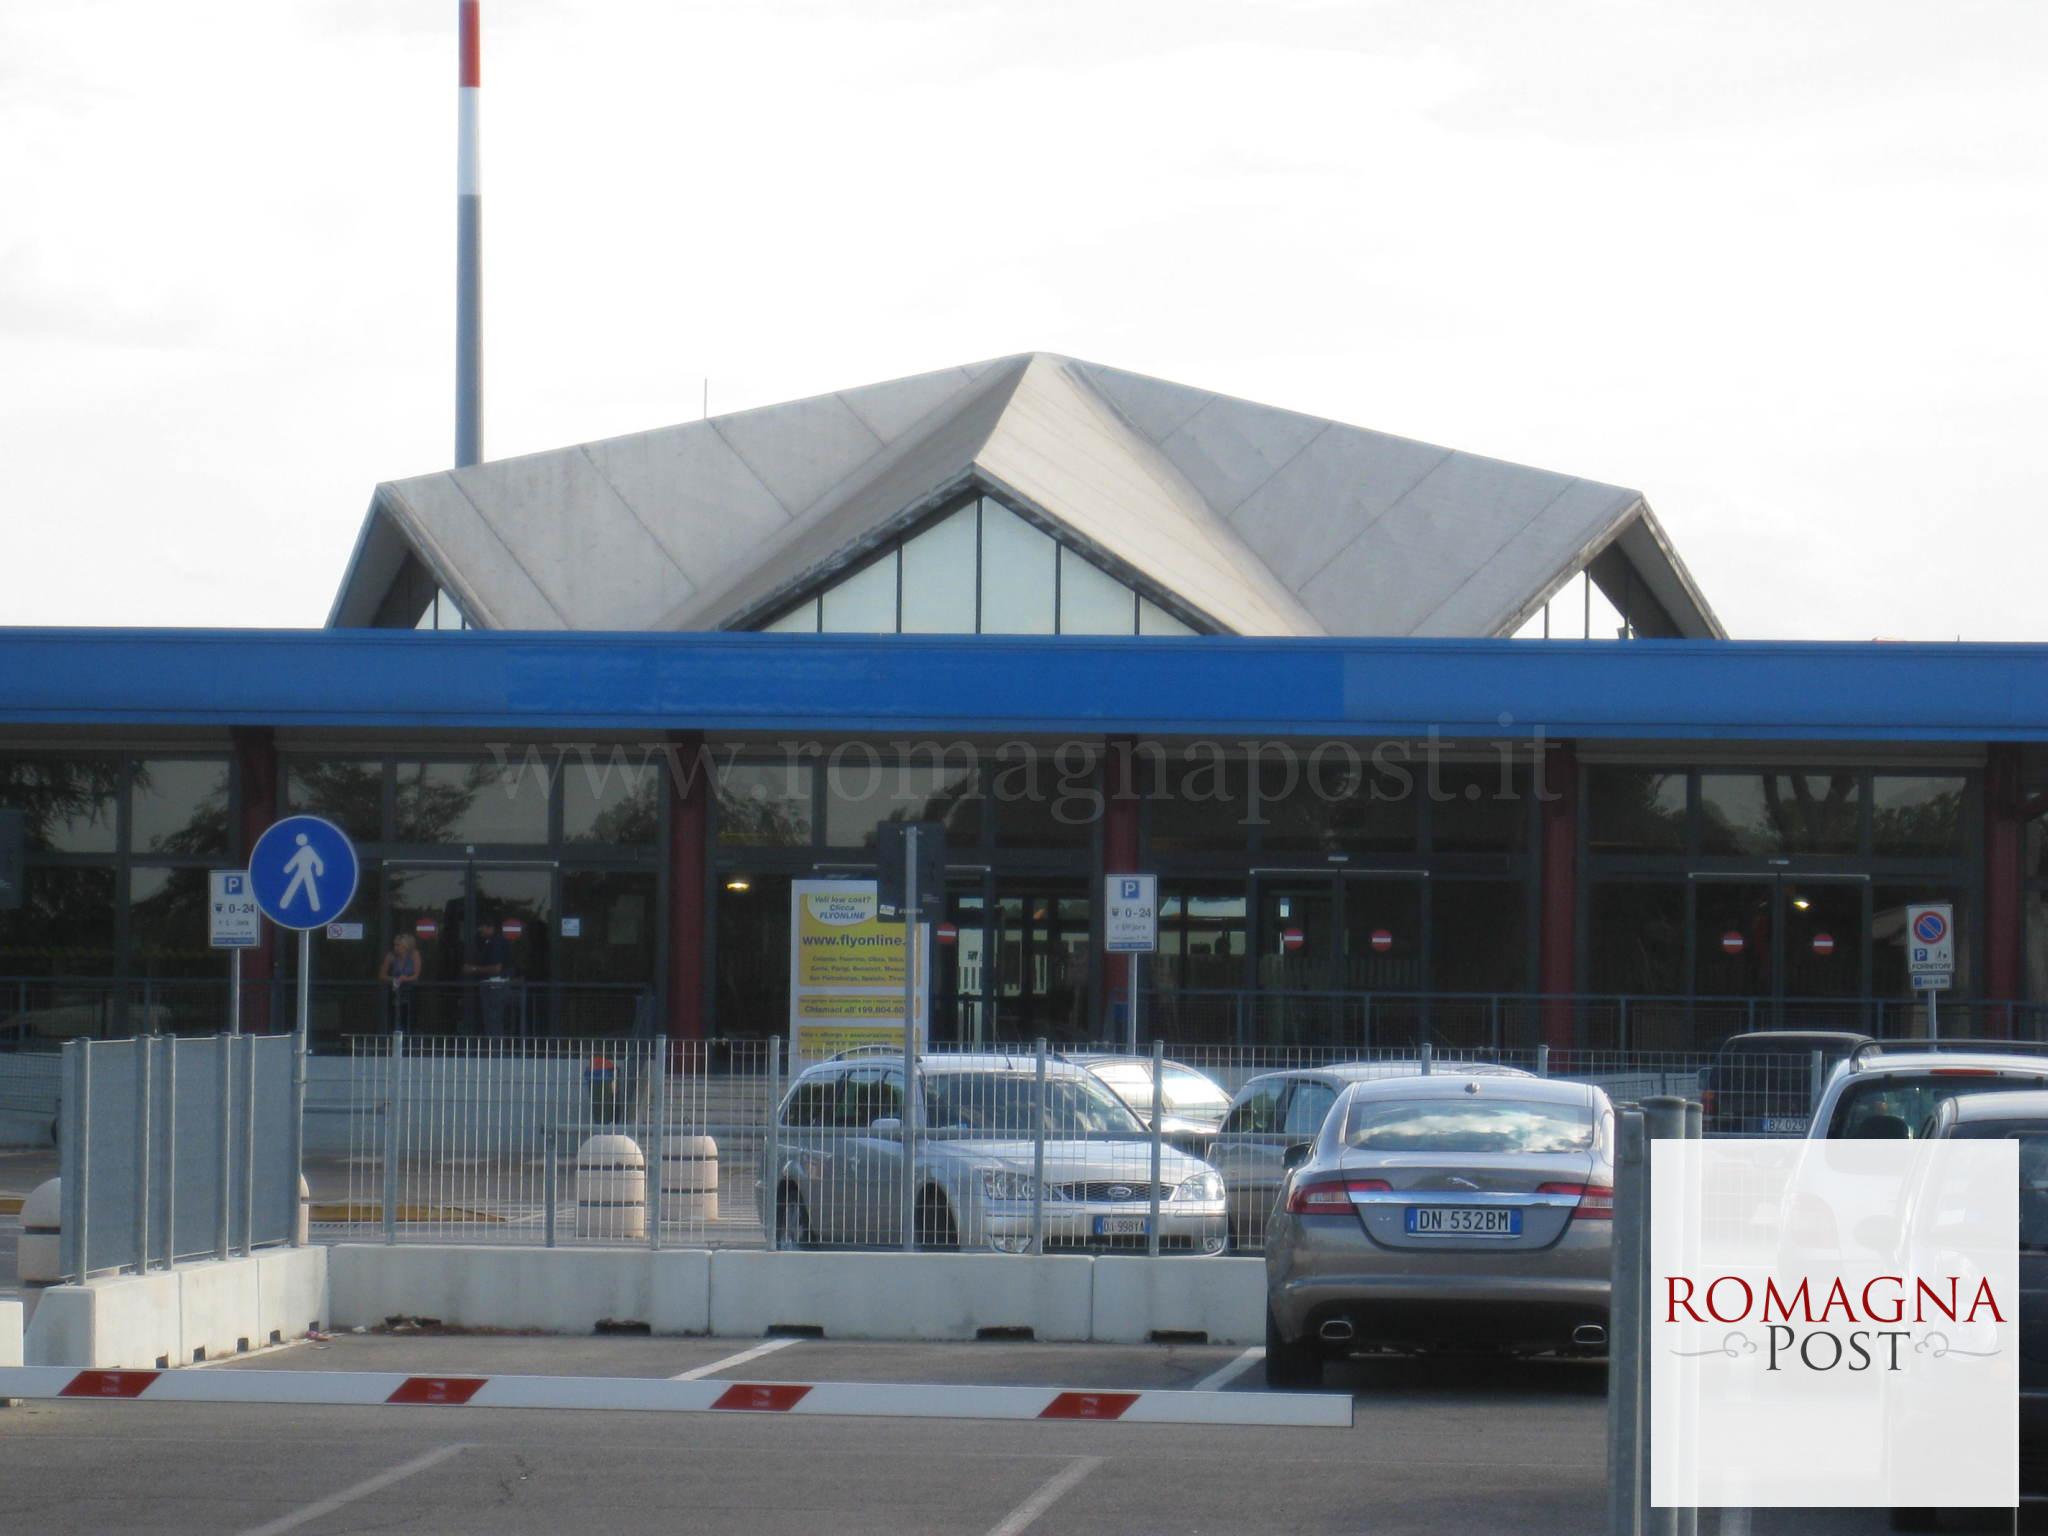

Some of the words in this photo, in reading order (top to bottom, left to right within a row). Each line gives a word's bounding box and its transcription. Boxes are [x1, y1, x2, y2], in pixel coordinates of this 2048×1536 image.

[1125, 882, 1137, 897] P
[1419, 1210, 1442, 1230] DN
[1450, 1211, 1509, 1231] 532BM
